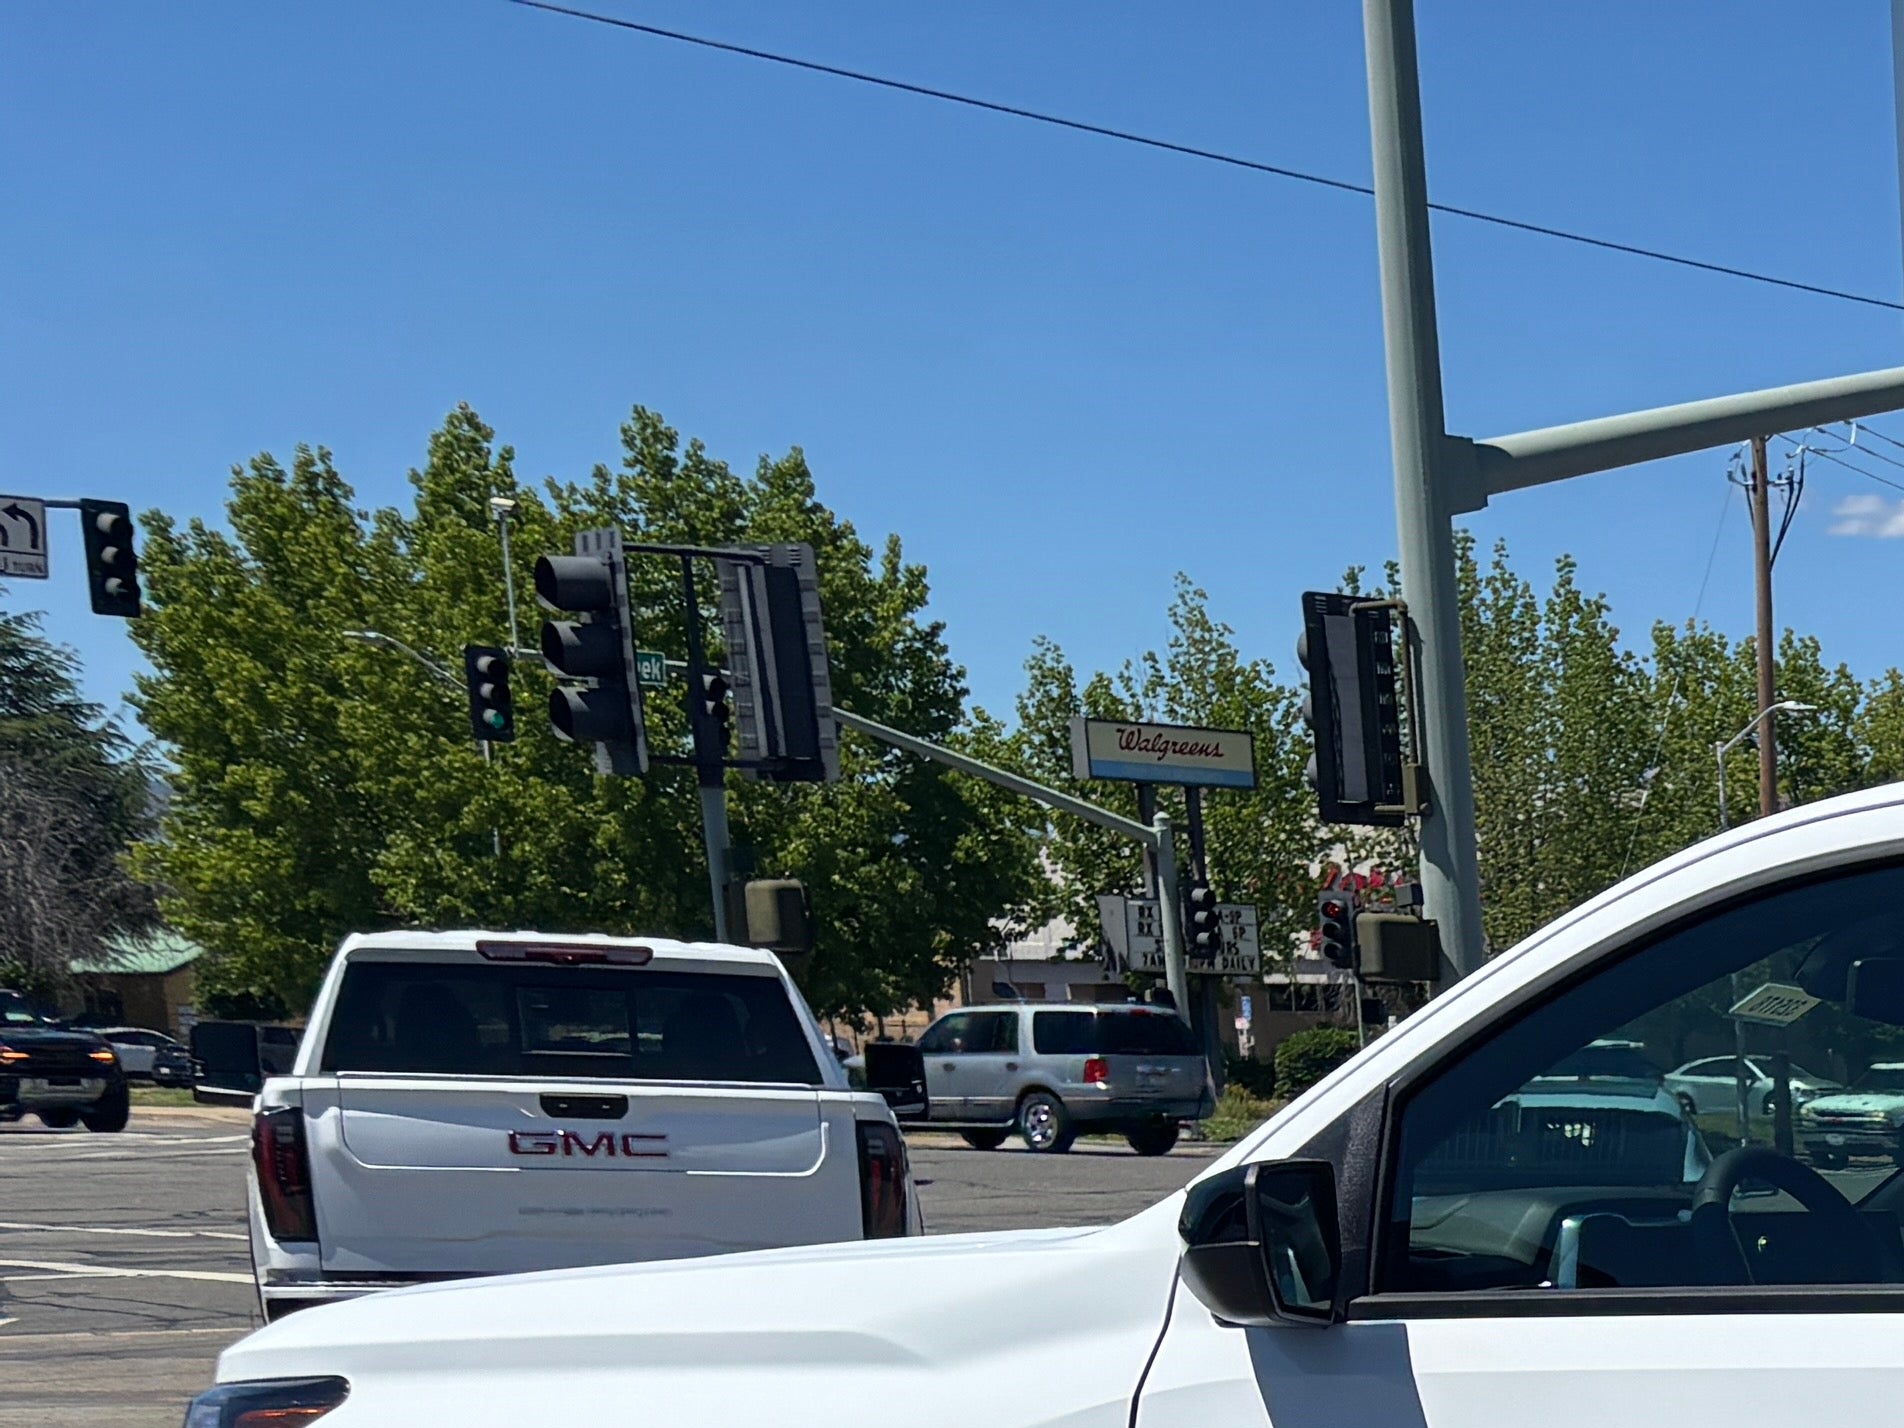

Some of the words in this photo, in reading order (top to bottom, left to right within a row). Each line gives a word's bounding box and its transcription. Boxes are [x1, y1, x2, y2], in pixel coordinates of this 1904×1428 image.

[637, 657, 661, 680] ek
[1116, 728, 1224, 761] Walgreens
[508, 1129, 668, 1157] GMC
